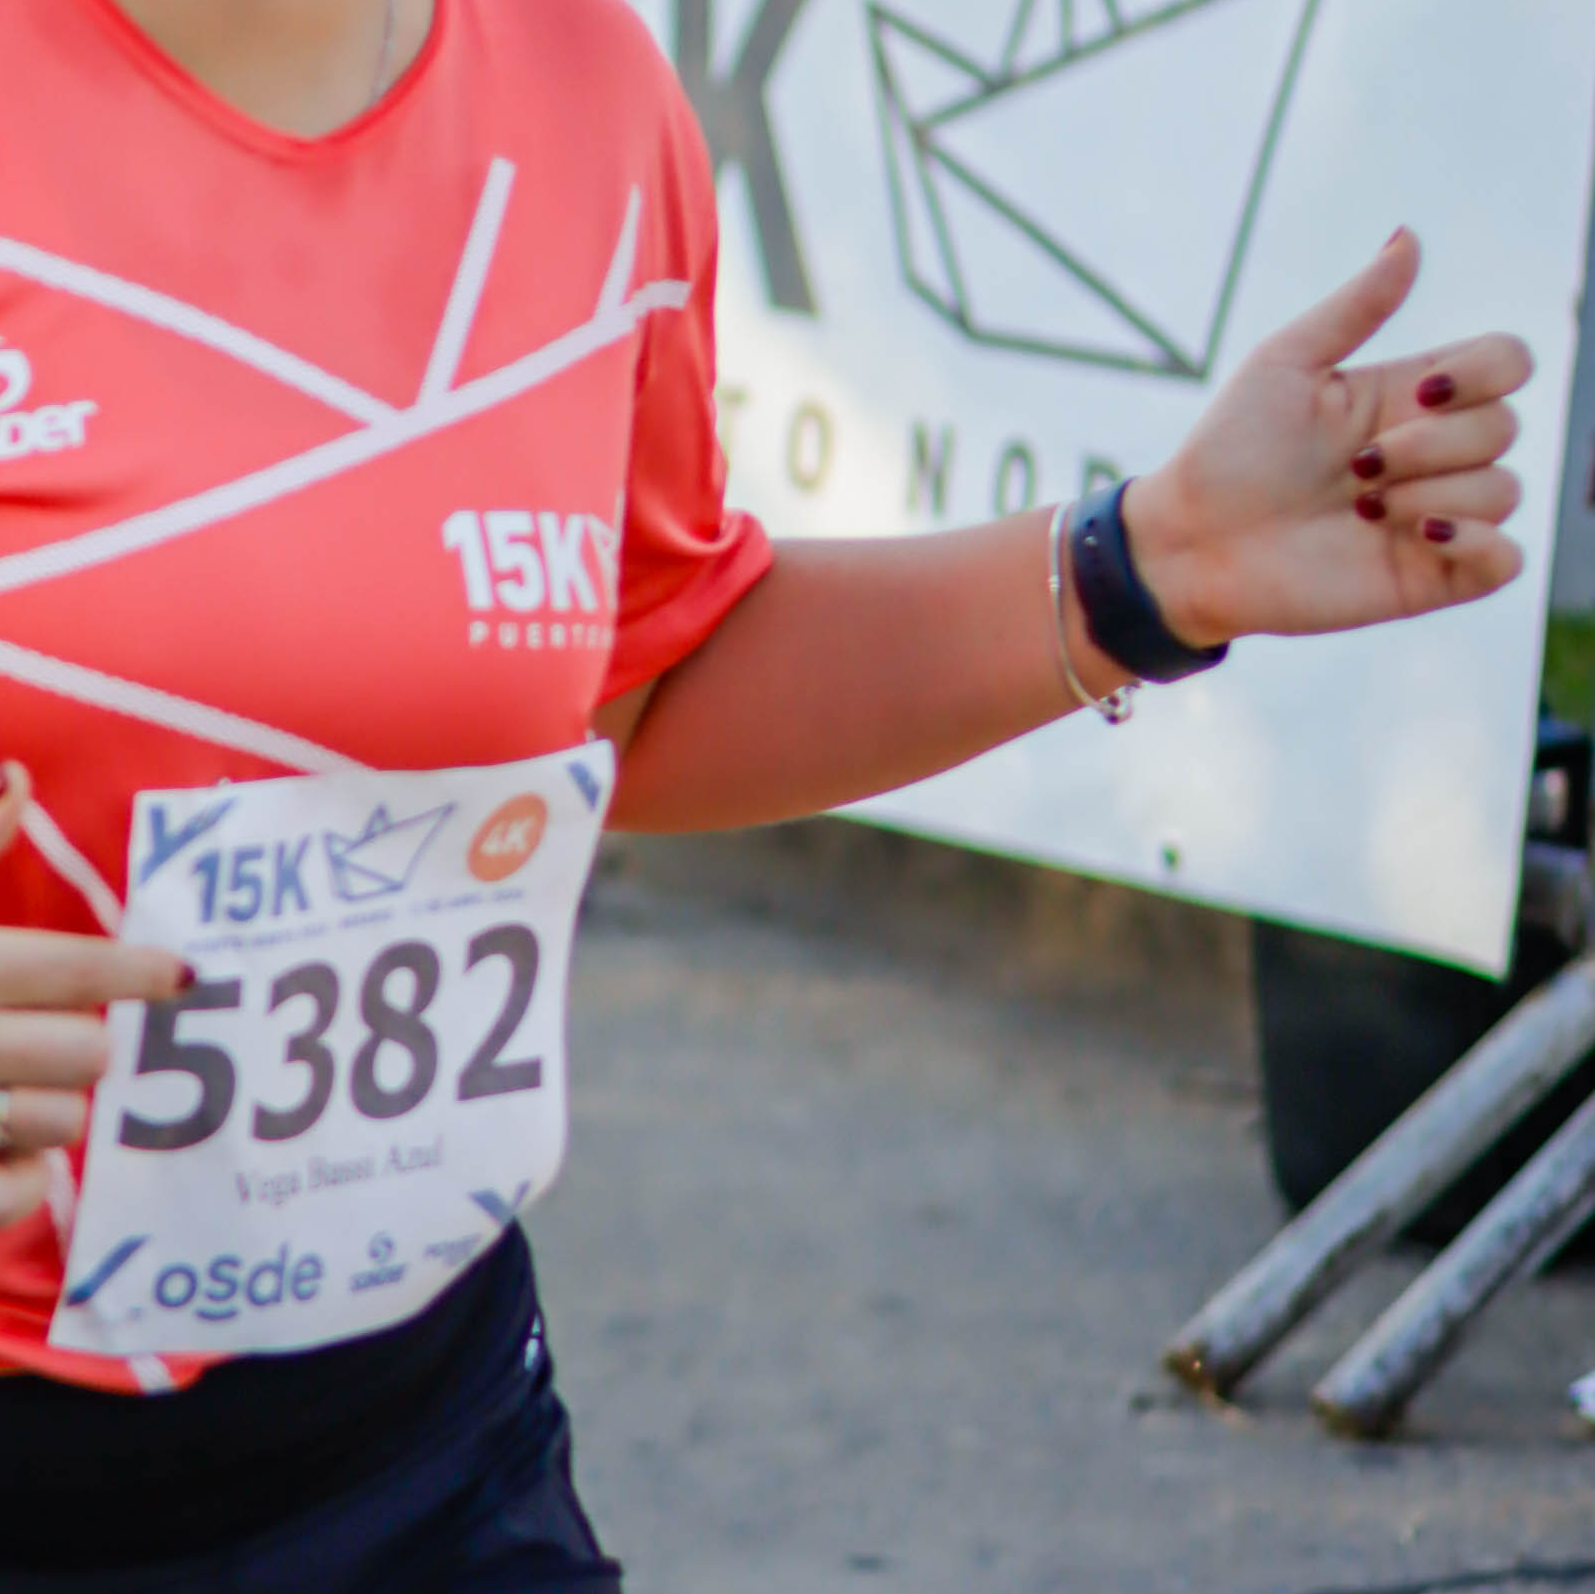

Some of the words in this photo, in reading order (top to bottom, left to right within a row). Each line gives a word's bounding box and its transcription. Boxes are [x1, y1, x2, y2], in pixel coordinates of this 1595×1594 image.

[442, 509, 600, 613] 15K
[191, 833, 311, 925] 15K
[117, 922, 542, 1151] 5382
[155, 1242, 324, 1308] osde
